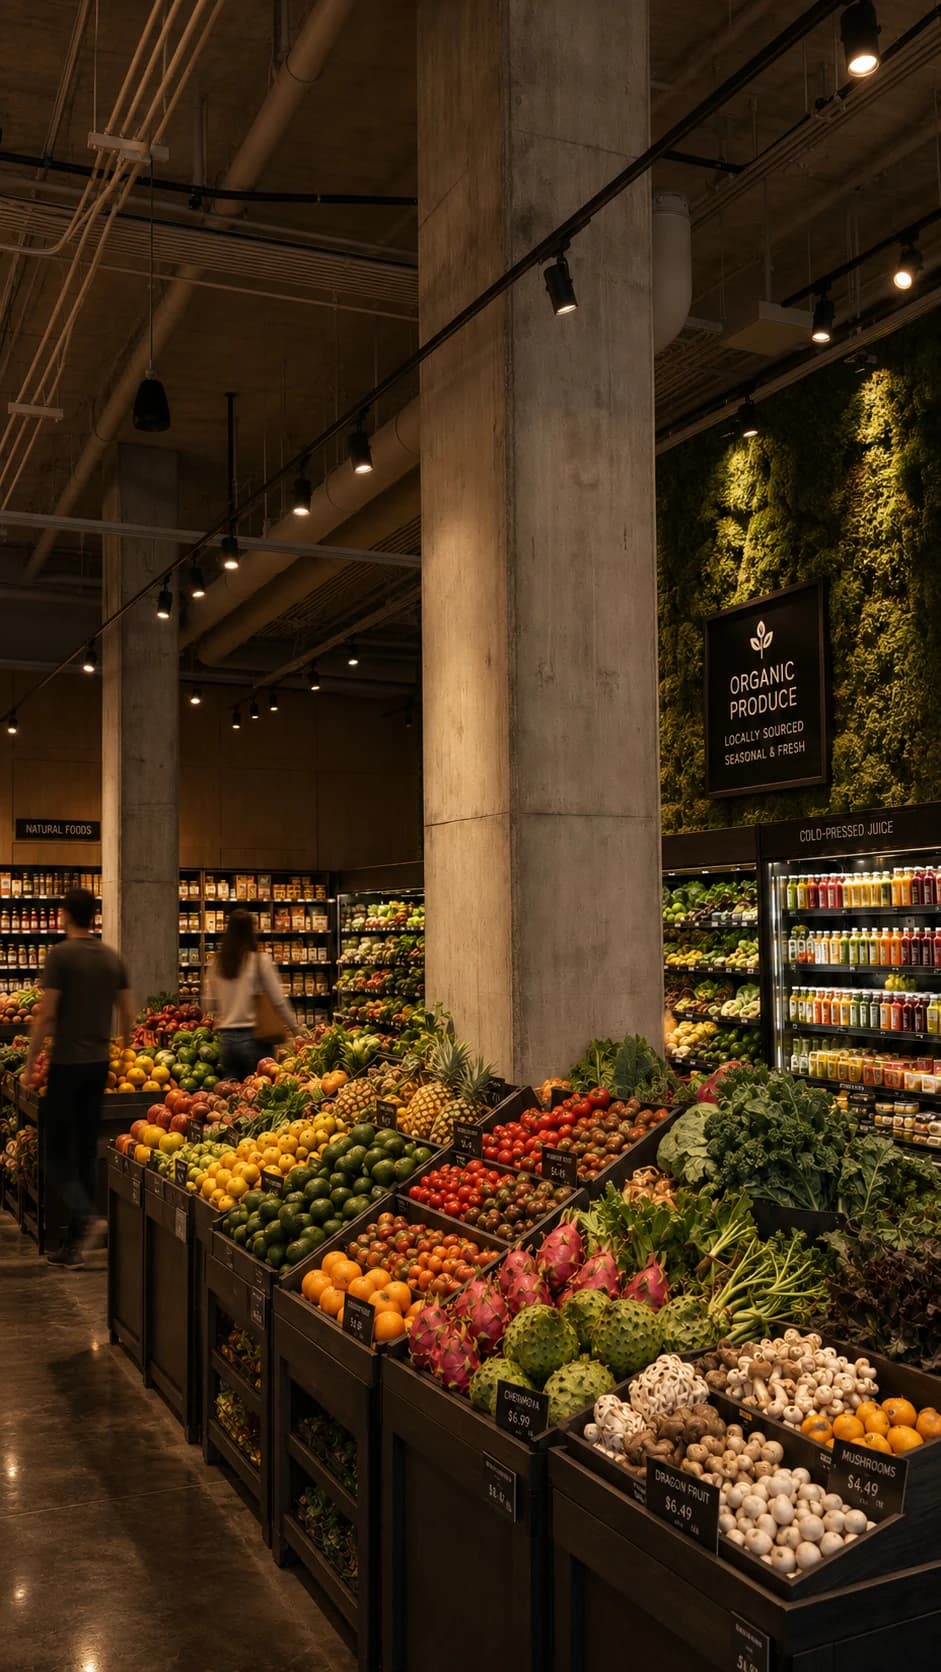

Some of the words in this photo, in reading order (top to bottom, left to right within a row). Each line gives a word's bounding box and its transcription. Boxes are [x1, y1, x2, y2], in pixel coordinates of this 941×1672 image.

[730, 661, 795, 694] ORGANIC
[730, 686, 797, 720] PRODUCE
[724, 730, 760, 747] LOCALLY
[763, 720, 804, 739] SOURCED
[725, 748, 767, 766] SEASONAL
[769, 746, 775, 758] &
[778, 740, 805, 756] FRESH
[26, 824, 63, 834] NATURAL
[65, 825, 92, 835] FOODS
[800, 823, 865, 842] COLD-PRESSED
[867, 820, 894, 836] JUICE
[508, 1410, 530, 1428] $6.99
[842, 1449, 896, 1478] MUSHROOMS
[655, 1469, 687, 1493] DRAGON
[687, 1484, 710, 1505] FRUIT
[848, 1474, 879, 1497] $4.49
[665, 1496, 692, 1521] $6.49
